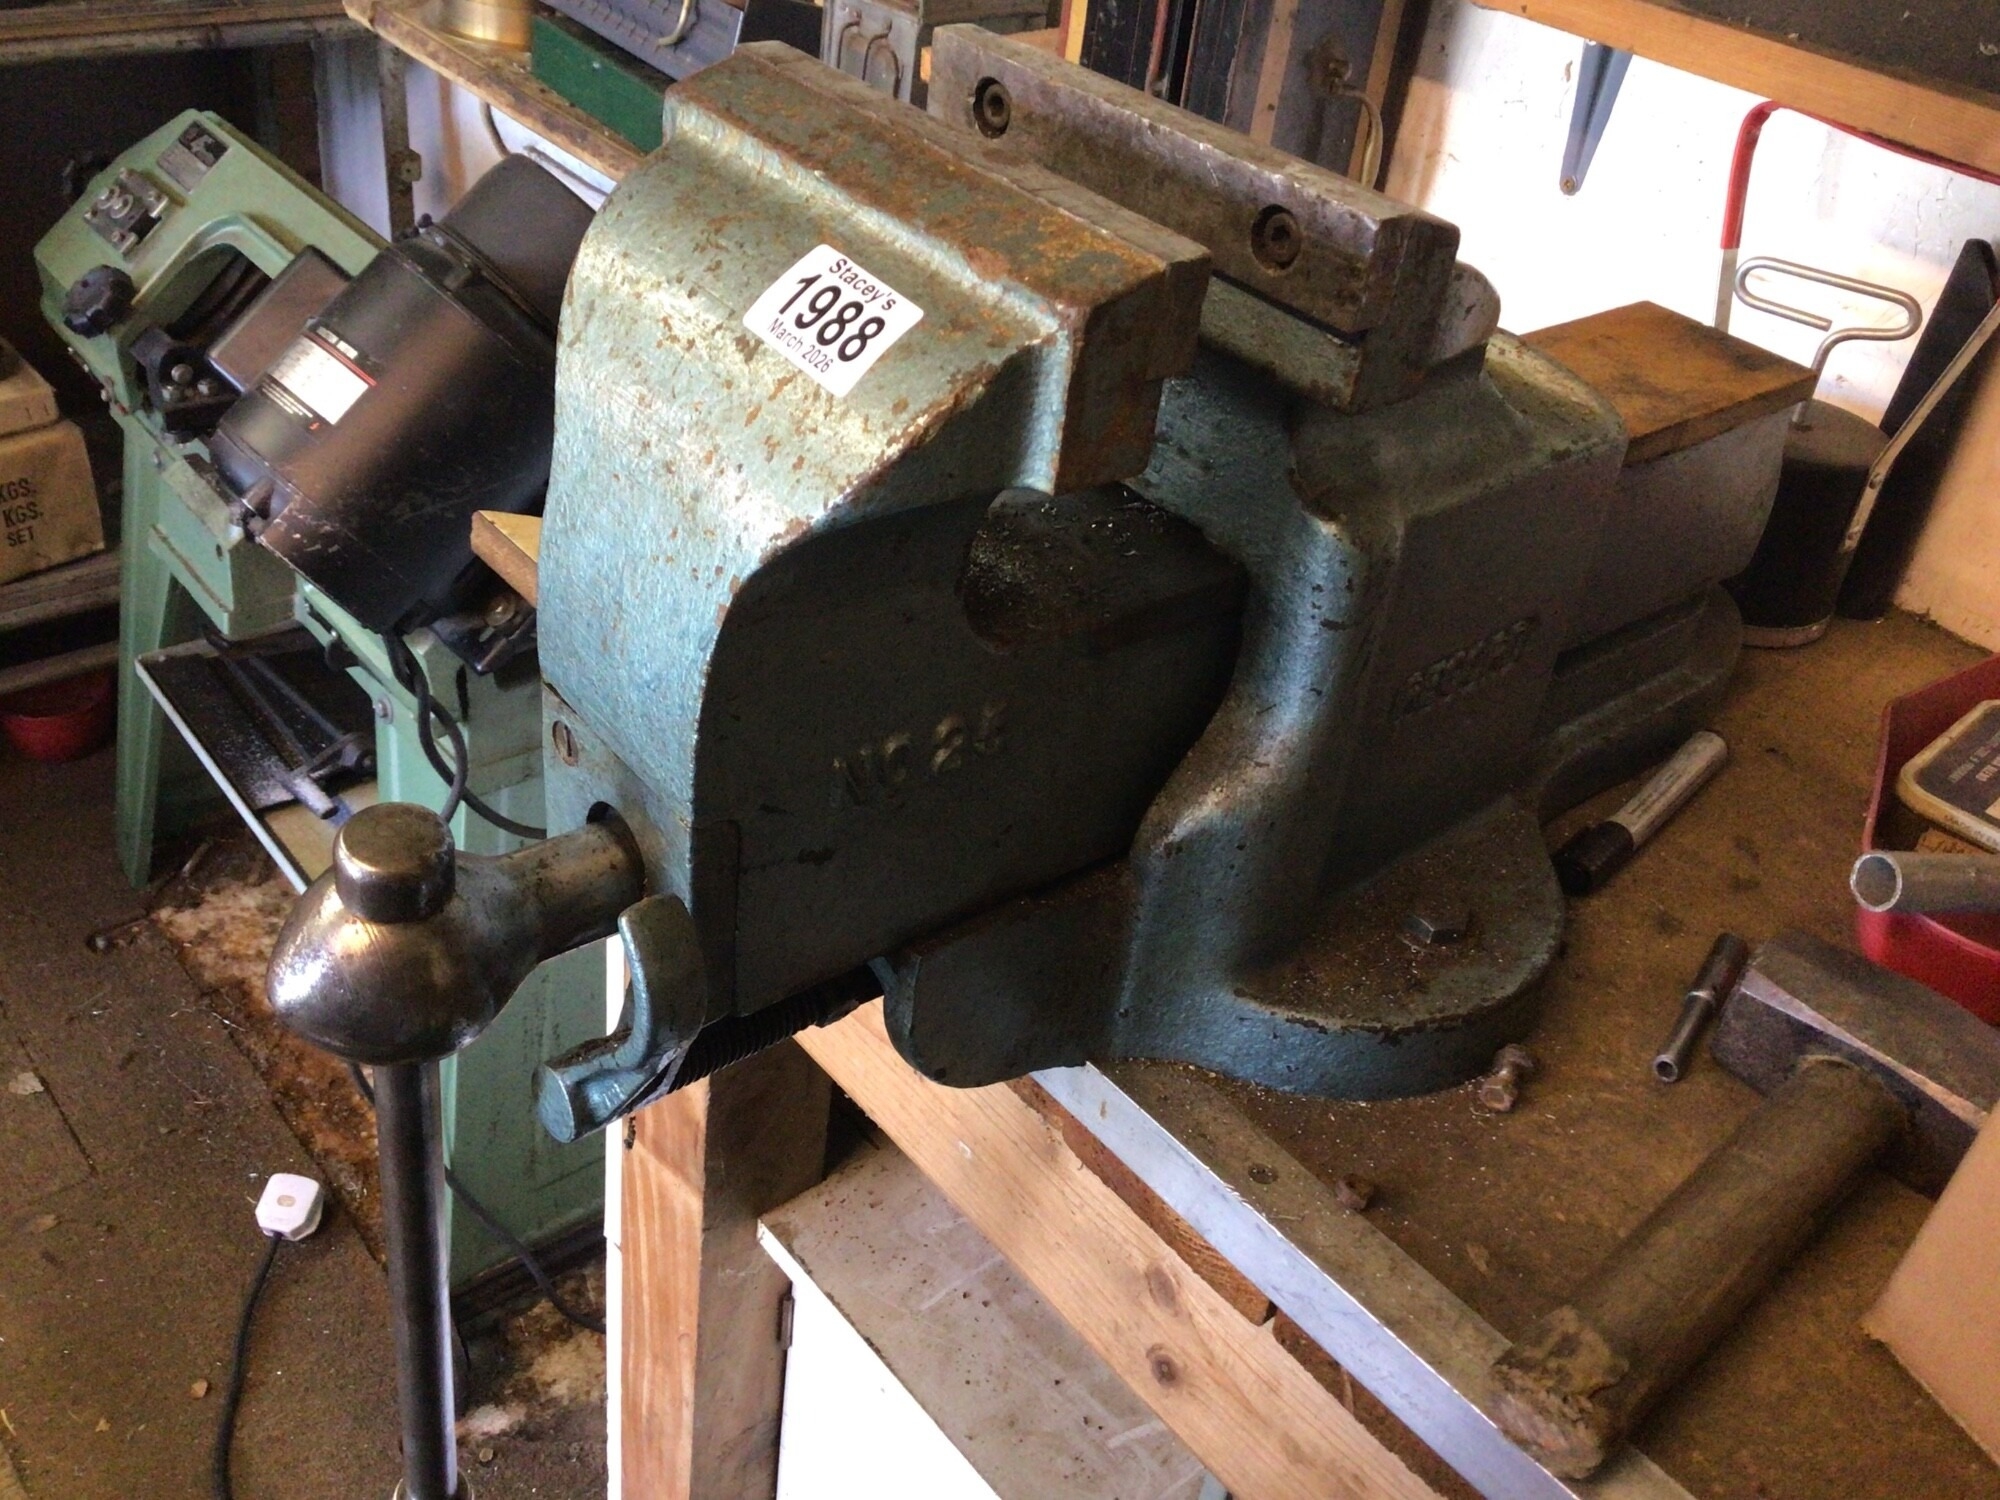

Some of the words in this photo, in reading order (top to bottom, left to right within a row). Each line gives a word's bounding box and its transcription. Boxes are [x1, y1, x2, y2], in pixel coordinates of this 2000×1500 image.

[829, 258, 897, 312] Stacey's
[778, 273, 886, 362] 1988
[768, 317, 804, 353] March
[801, 344, 834, 373] 2026
[2, 501, 44, 528] KGS.
[7, 526, 34, 547] SET
